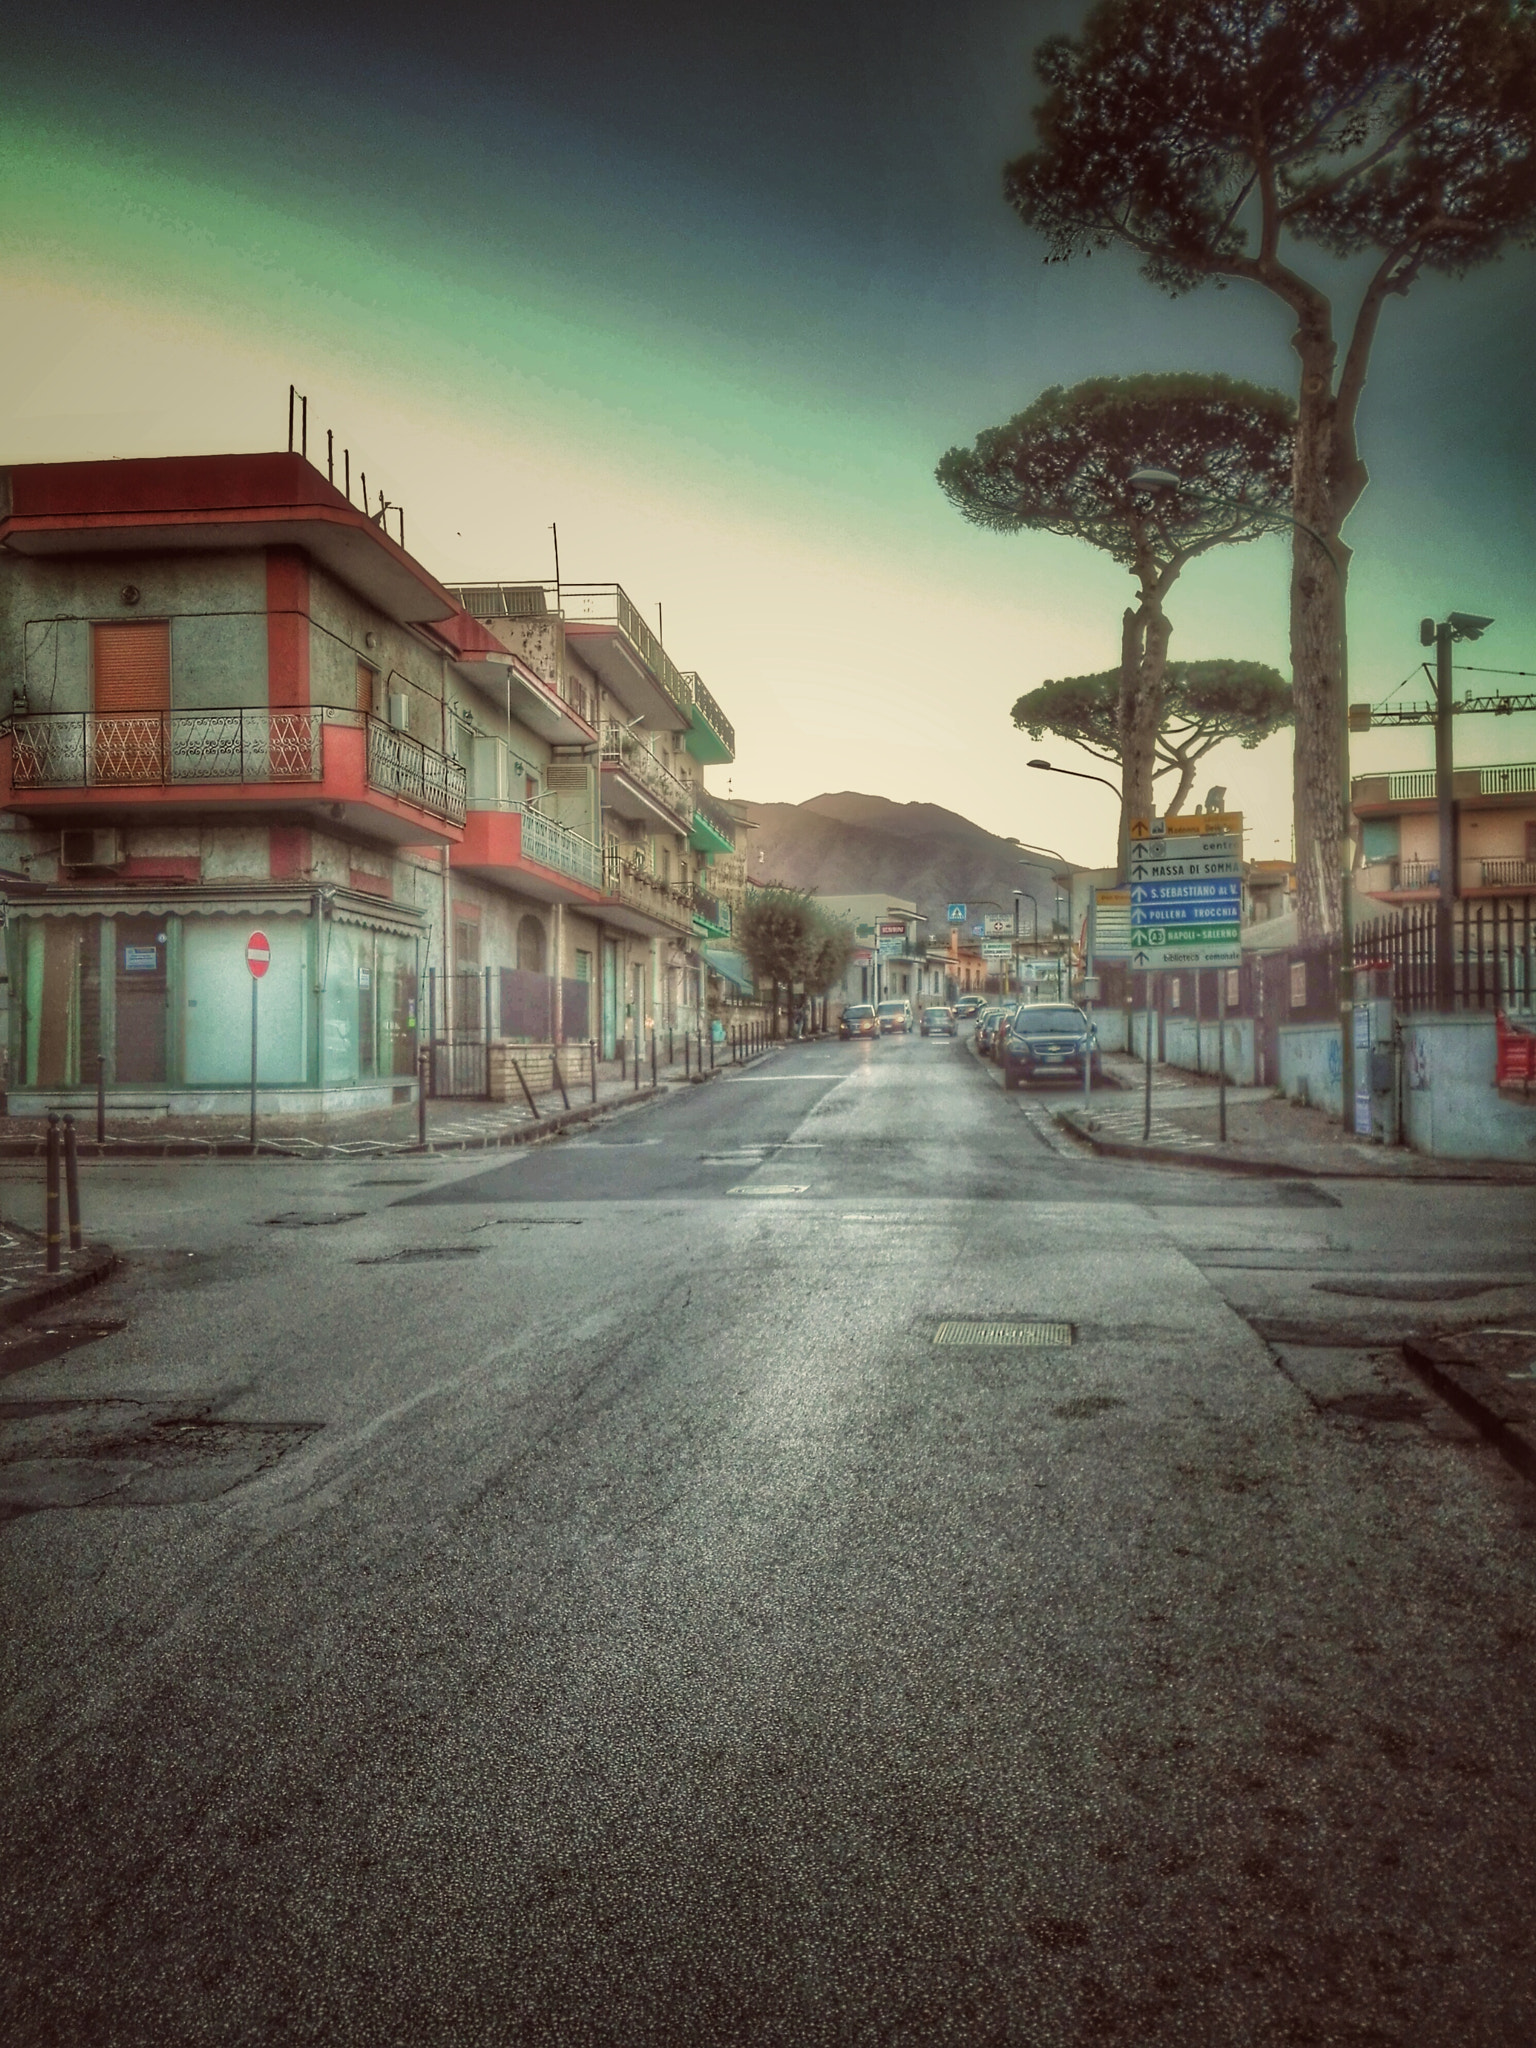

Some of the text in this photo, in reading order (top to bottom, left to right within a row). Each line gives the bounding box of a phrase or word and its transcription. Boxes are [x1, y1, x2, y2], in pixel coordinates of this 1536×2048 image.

[1152, 862, 1239, 877] MASSA DI SOMMA
[1151, 888, 1158, 898] S.
[1160, 886, 1216, 898] SEBASTIANO
[1149, 907, 1237, 919] POLLENA TROCCHIA
[1152, 932, 1163, 941] A3
